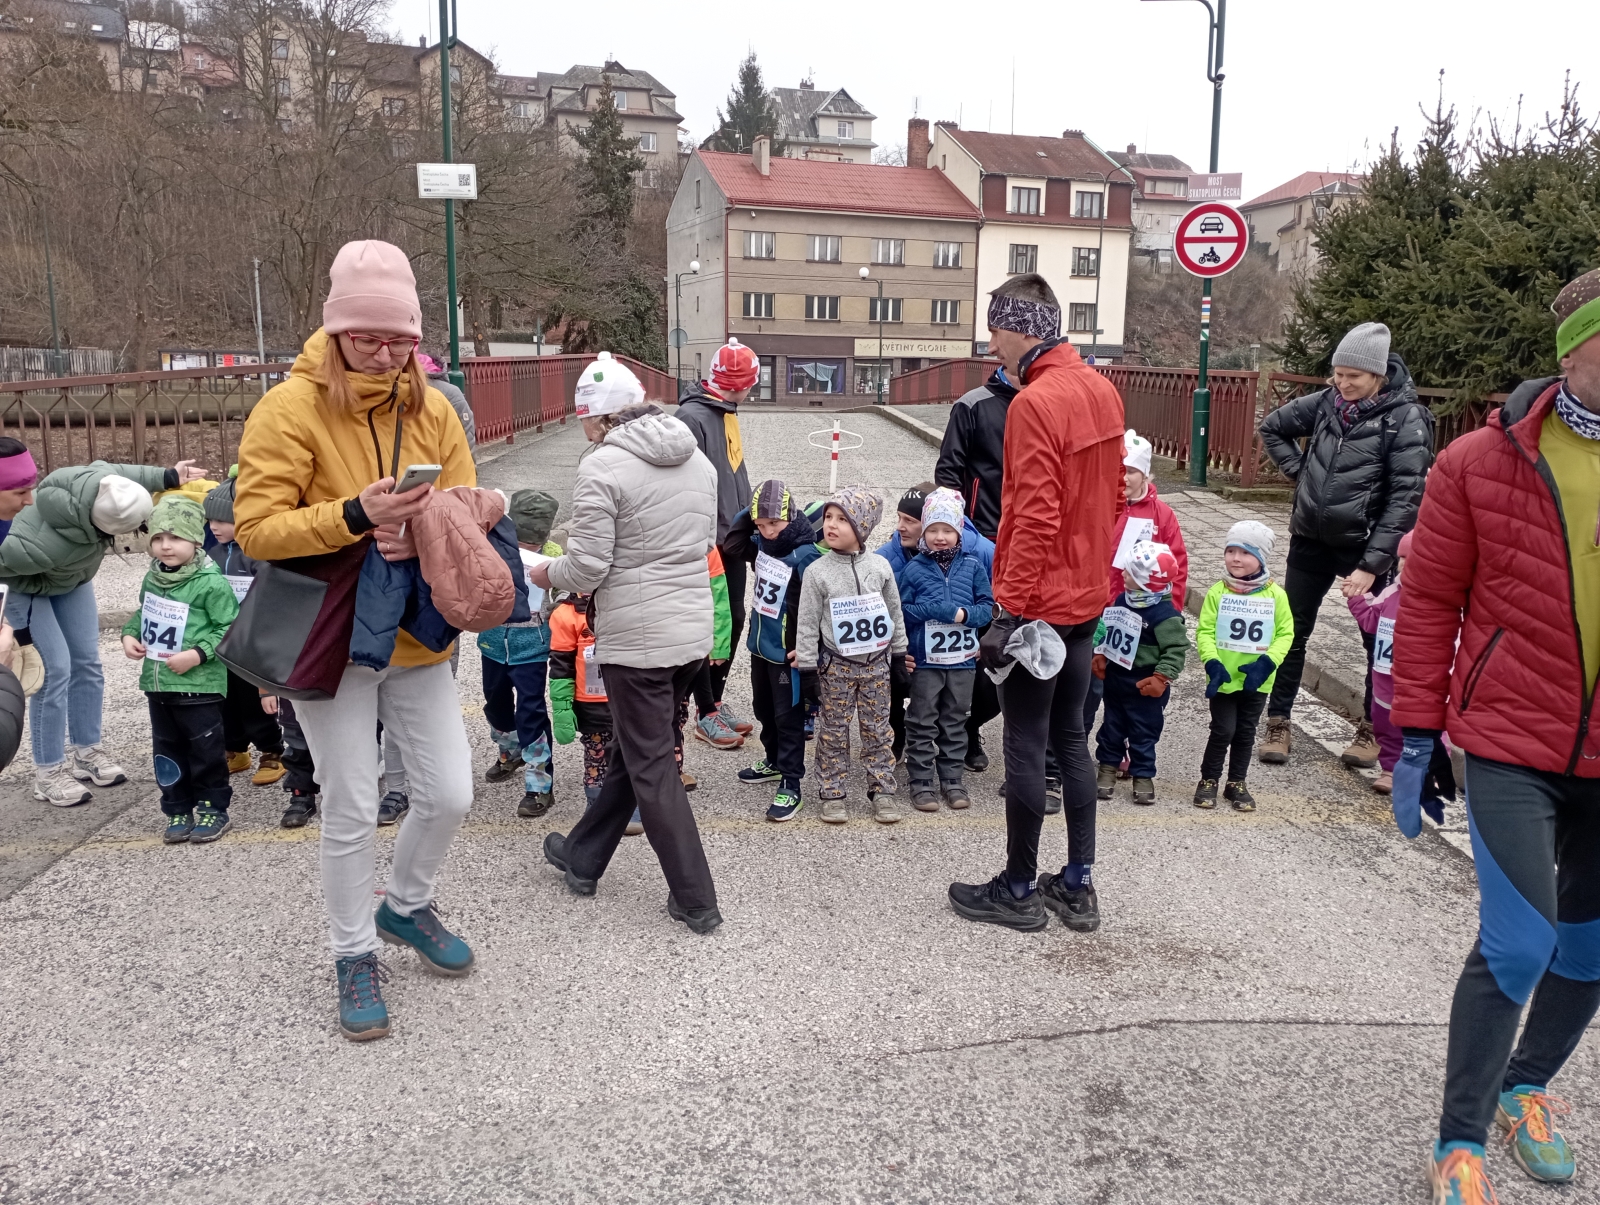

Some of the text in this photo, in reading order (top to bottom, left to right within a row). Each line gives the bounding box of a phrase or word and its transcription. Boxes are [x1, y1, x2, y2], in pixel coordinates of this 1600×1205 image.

[1207, 177, 1223, 186] MOST
[1189, 186, 1240, 198] SVATOPLUKA ČECHA
[917, 344, 947, 352] GLORIE
[832, 598, 858, 609] ZIMNÍ
[871, 603, 886, 611] LIGA
[1221, 597, 1248, 606] ZIMNÍ
[164, 612, 184, 621] LIGA
[838, 615, 888, 645] 286
[1229, 618, 1264, 643] 96
[930, 629, 976, 653] 225
[1105, 625, 1135, 655] 103
